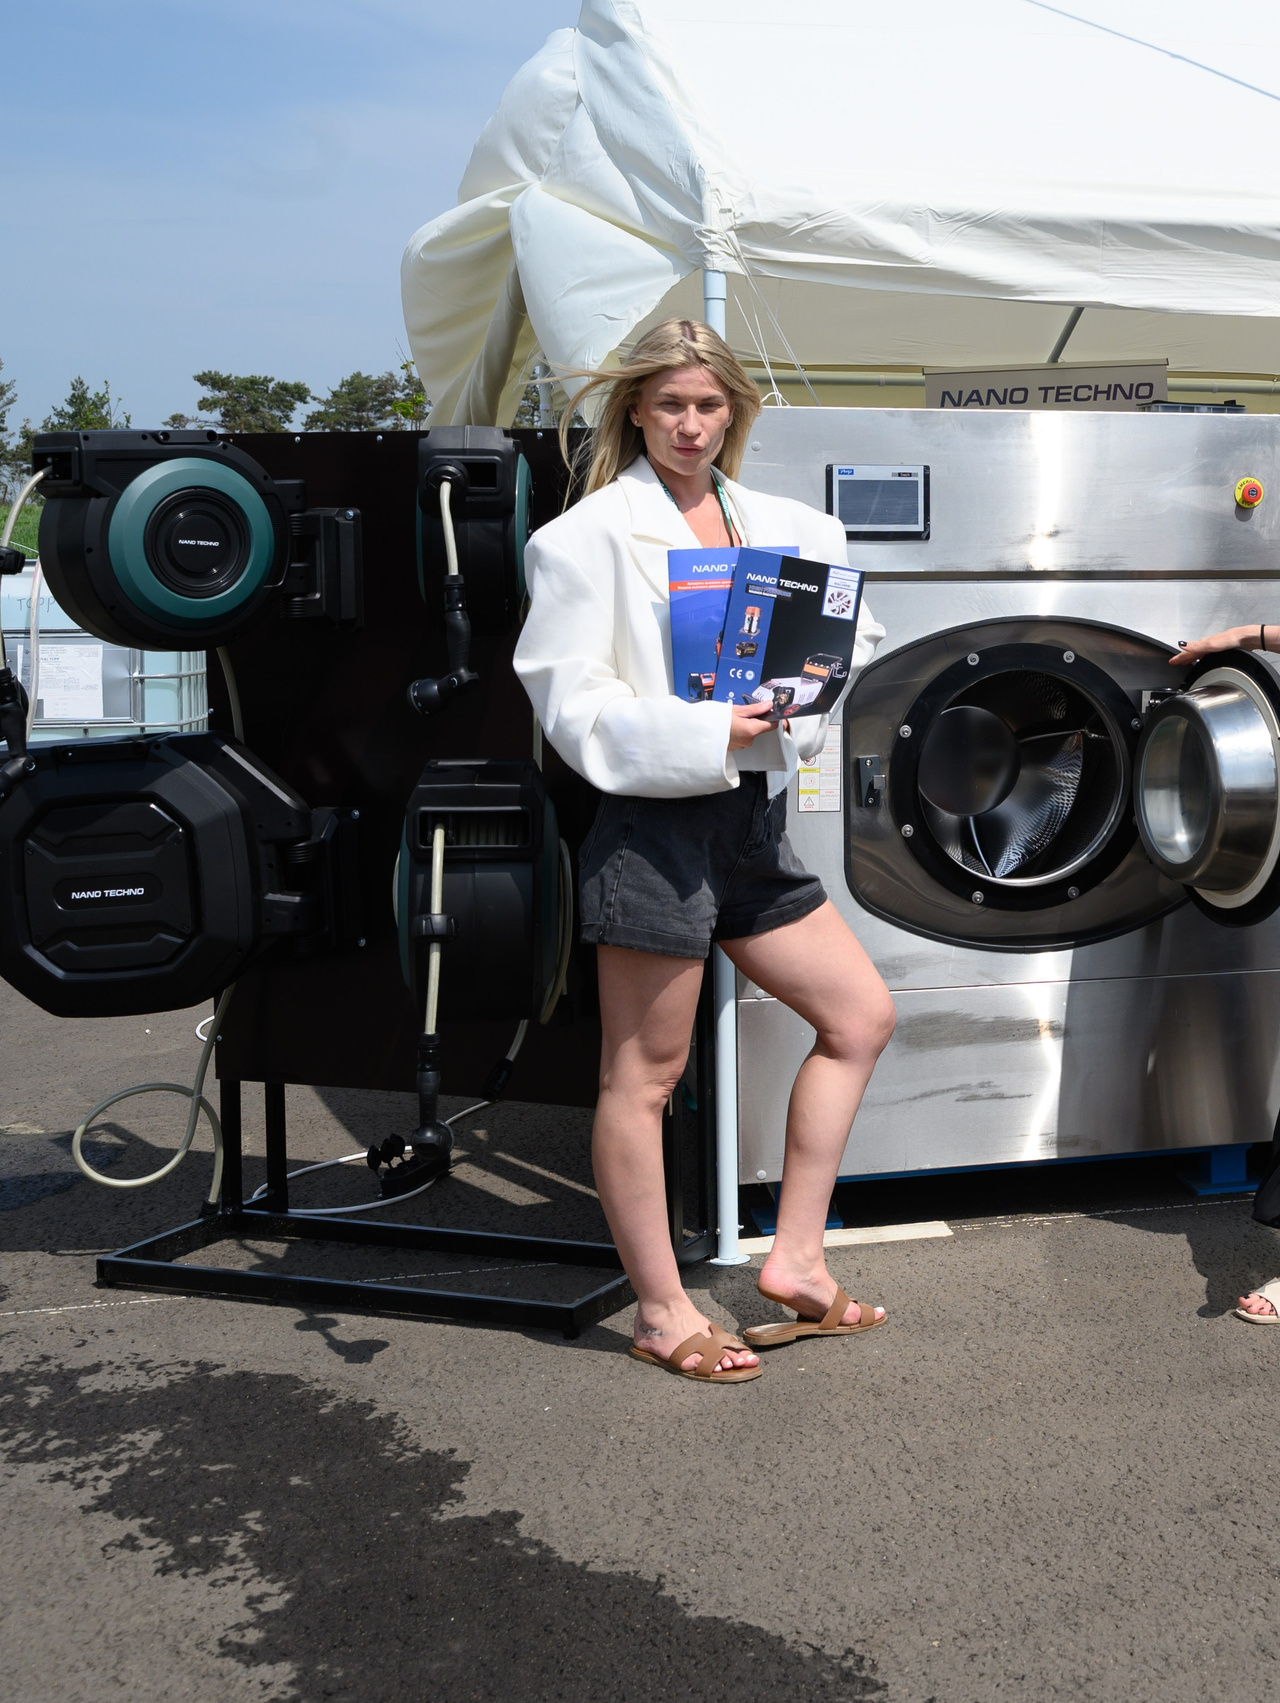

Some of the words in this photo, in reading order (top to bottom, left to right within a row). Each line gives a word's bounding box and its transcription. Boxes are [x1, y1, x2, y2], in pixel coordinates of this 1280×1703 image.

[939, 386, 1029, 408] NANO
[1037, 382, 1155, 404] TECHNO
[692, 564, 728, 574] NANO
[746, 572, 778, 585] NANO
[779, 578, 819, 593] TECHNO
[71, 890, 101, 900] NANO
[103, 887, 145, 898] TECHNO
